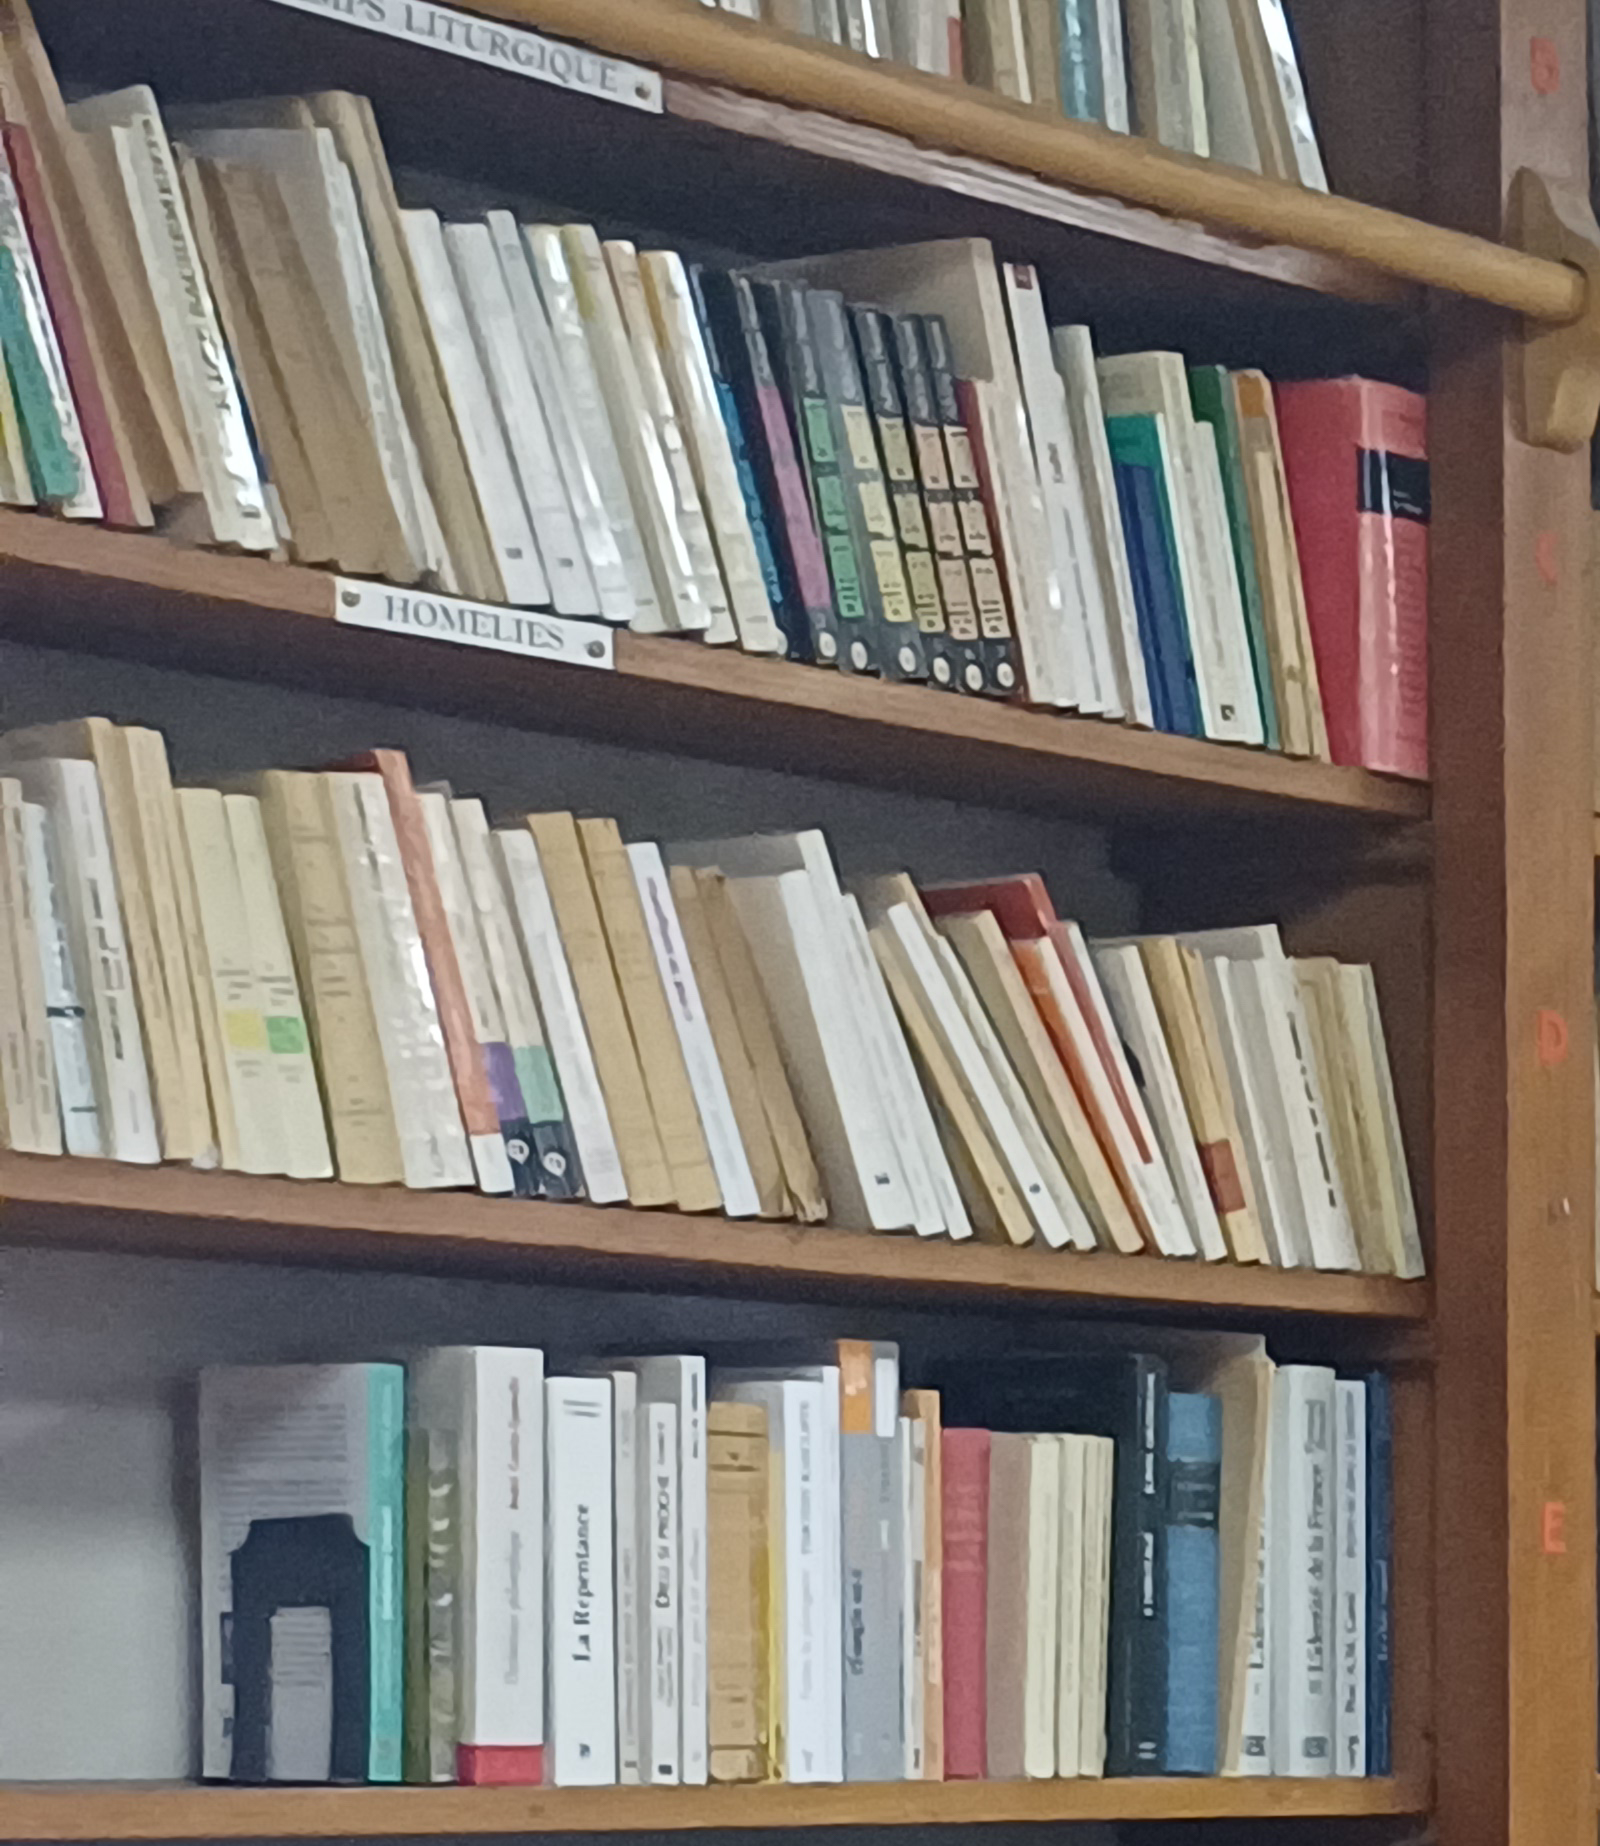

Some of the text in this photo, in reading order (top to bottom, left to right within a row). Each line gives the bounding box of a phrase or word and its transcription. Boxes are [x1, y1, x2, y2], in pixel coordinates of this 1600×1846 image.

[404, 3, 618, 93] LITURGIQUE
[384, 593, 562, 650] HOMELIES
[1537, 1011, 1567, 1065] D
[1540, 1503, 1563, 1555] E
[571, 1502, 594, 1662] La Repentance
